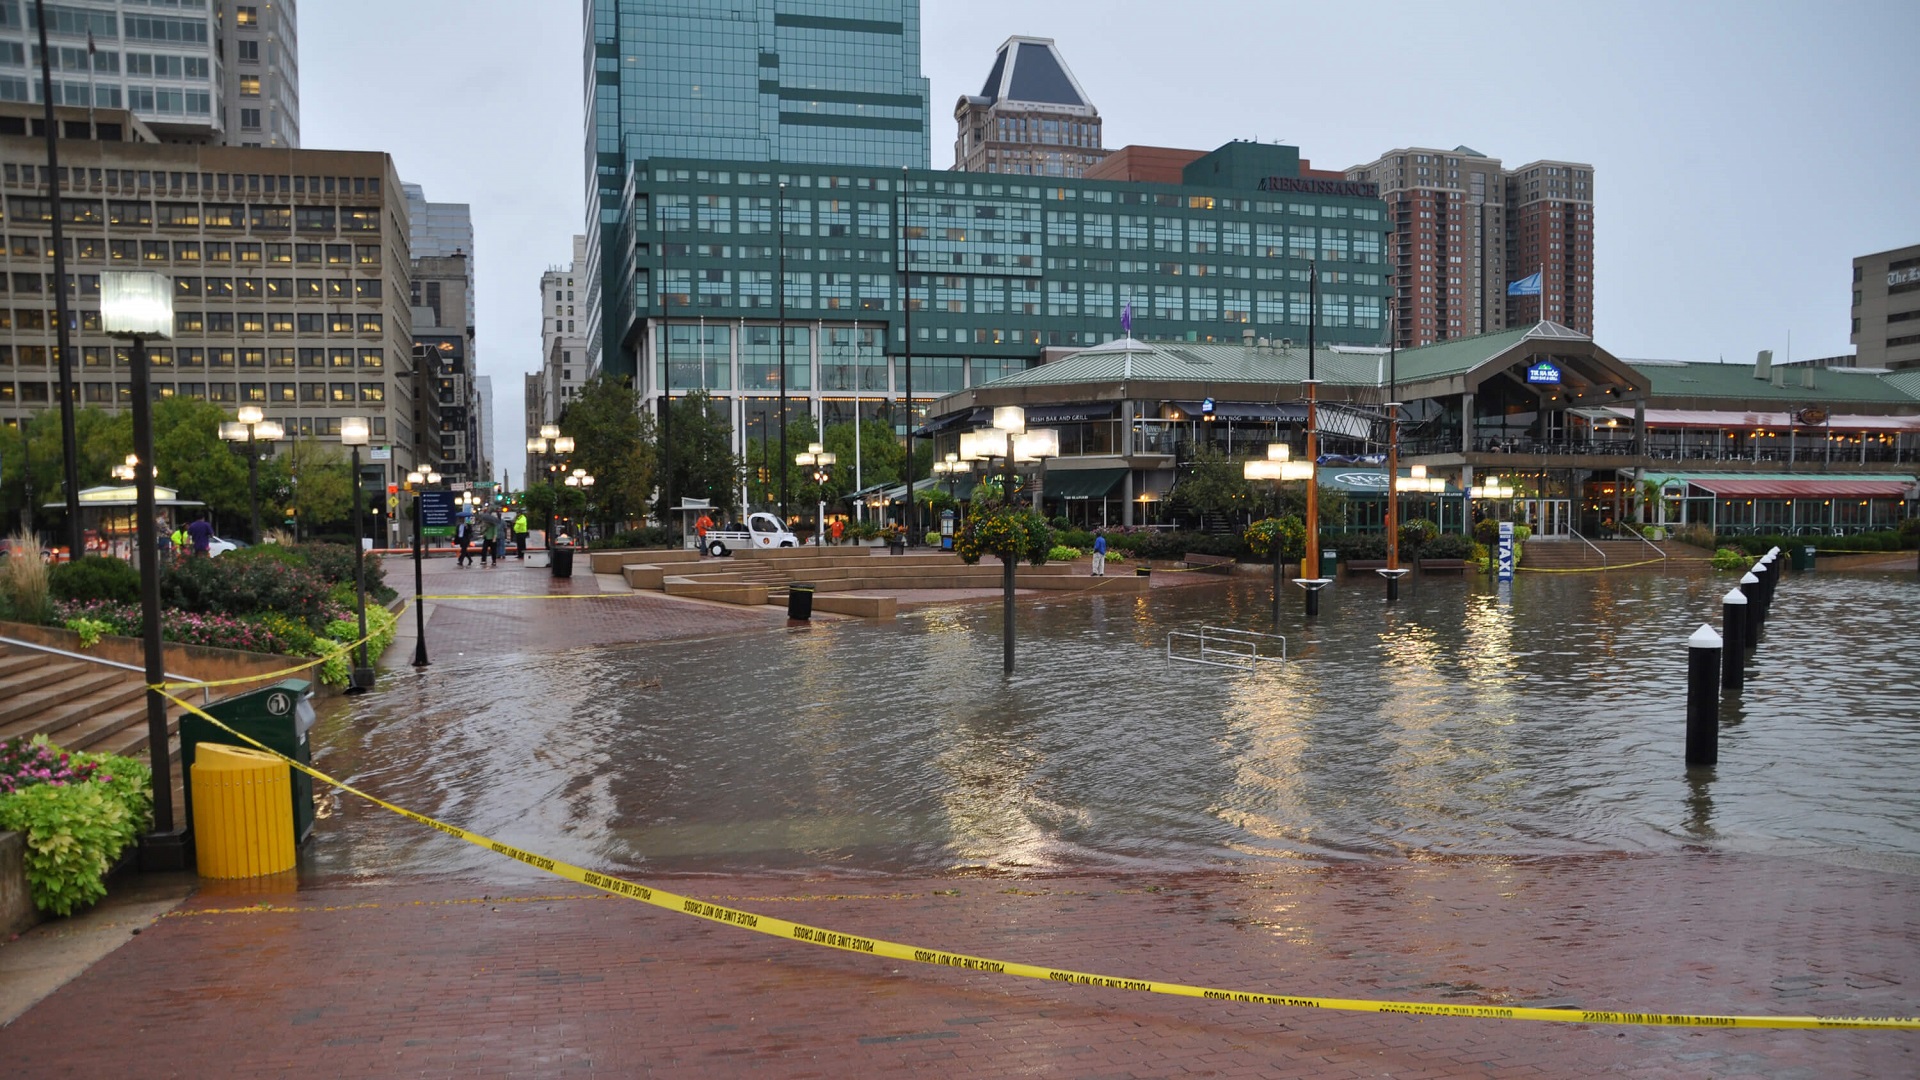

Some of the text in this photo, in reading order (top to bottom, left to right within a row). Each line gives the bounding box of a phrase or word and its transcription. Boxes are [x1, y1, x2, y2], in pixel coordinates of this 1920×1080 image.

[1268, 176, 1376, 198] RENAISSANCE
[1500, 538, 1511, 576] TAXI
[536, 857, 555, 871] POLICE
[584, 872, 652, 900] POLICE LINE DO NOT CROSS
[684, 900, 758, 928] POLICE LINE DO NOT CROSS
[794, 926, 874, 952] POLICE LINE DO NOT CROSS
[914, 950, 1004, 973] POLICE LINE DO NOT CROSS
